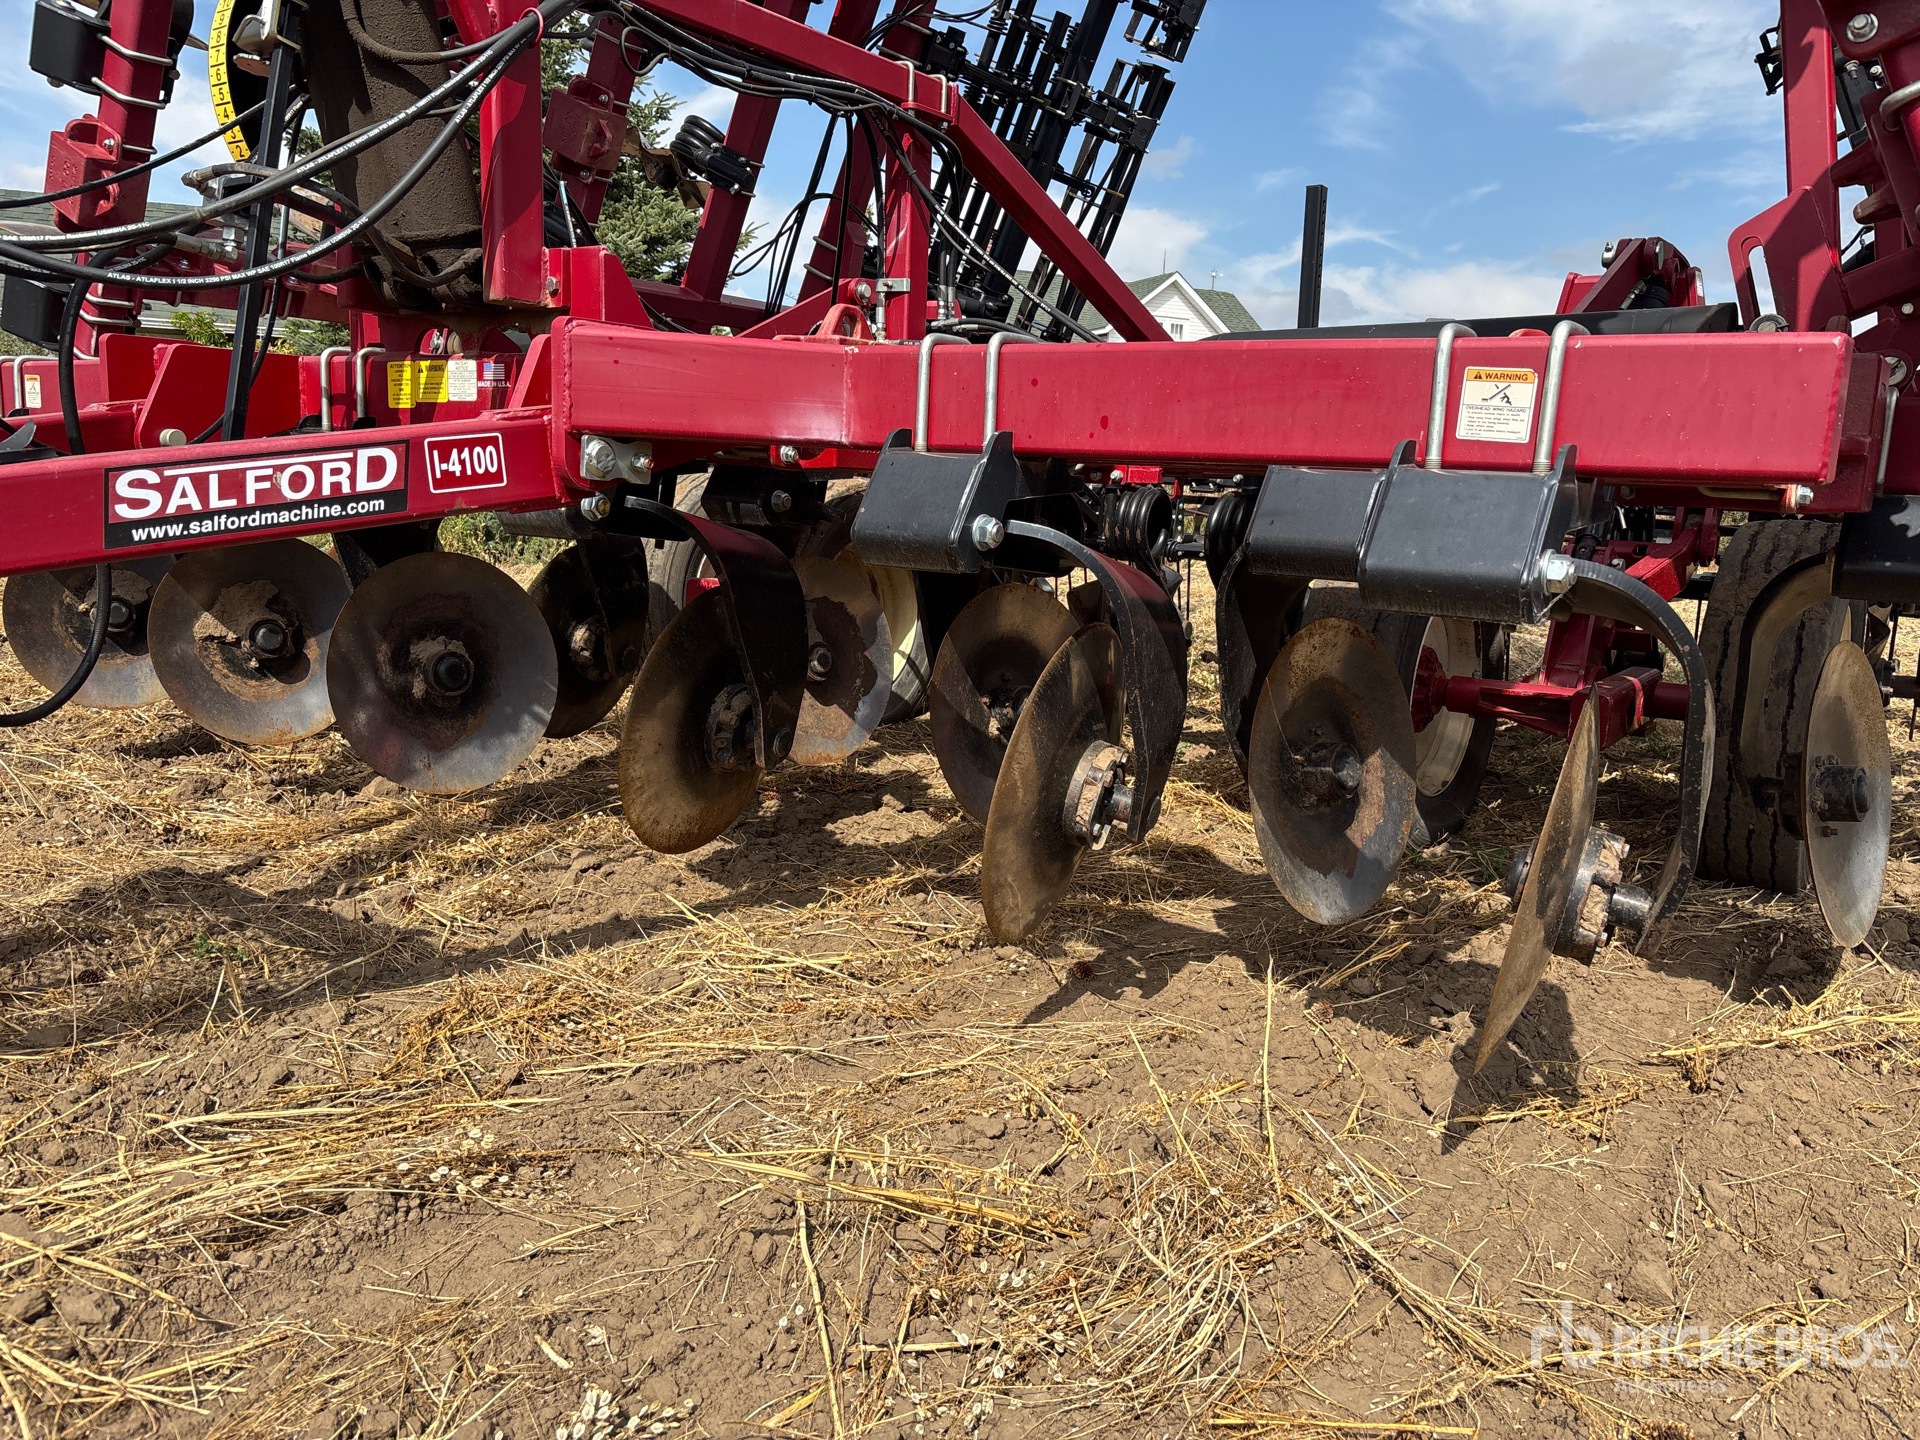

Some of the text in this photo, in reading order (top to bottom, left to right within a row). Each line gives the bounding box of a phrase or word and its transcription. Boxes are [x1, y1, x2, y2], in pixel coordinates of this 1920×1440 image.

[219, 13, 225, 26] 9
[216, 30, 222, 44] 8
[215, 50, 220, 62] 7
[216, 68, 222, 82] 6
[218, 88, 224, 101] 5
[223, 107, 230, 121] 4
[230, 128, 237, 140] 3
[236, 144, 244, 158] 2
[1484, 372, 1528, 381] WARNING
[432, 445, 498, 480] I-4100
[114, 446, 398, 518] SALFORD
[131, 497, 386, 542] www.salfordmachine.com
